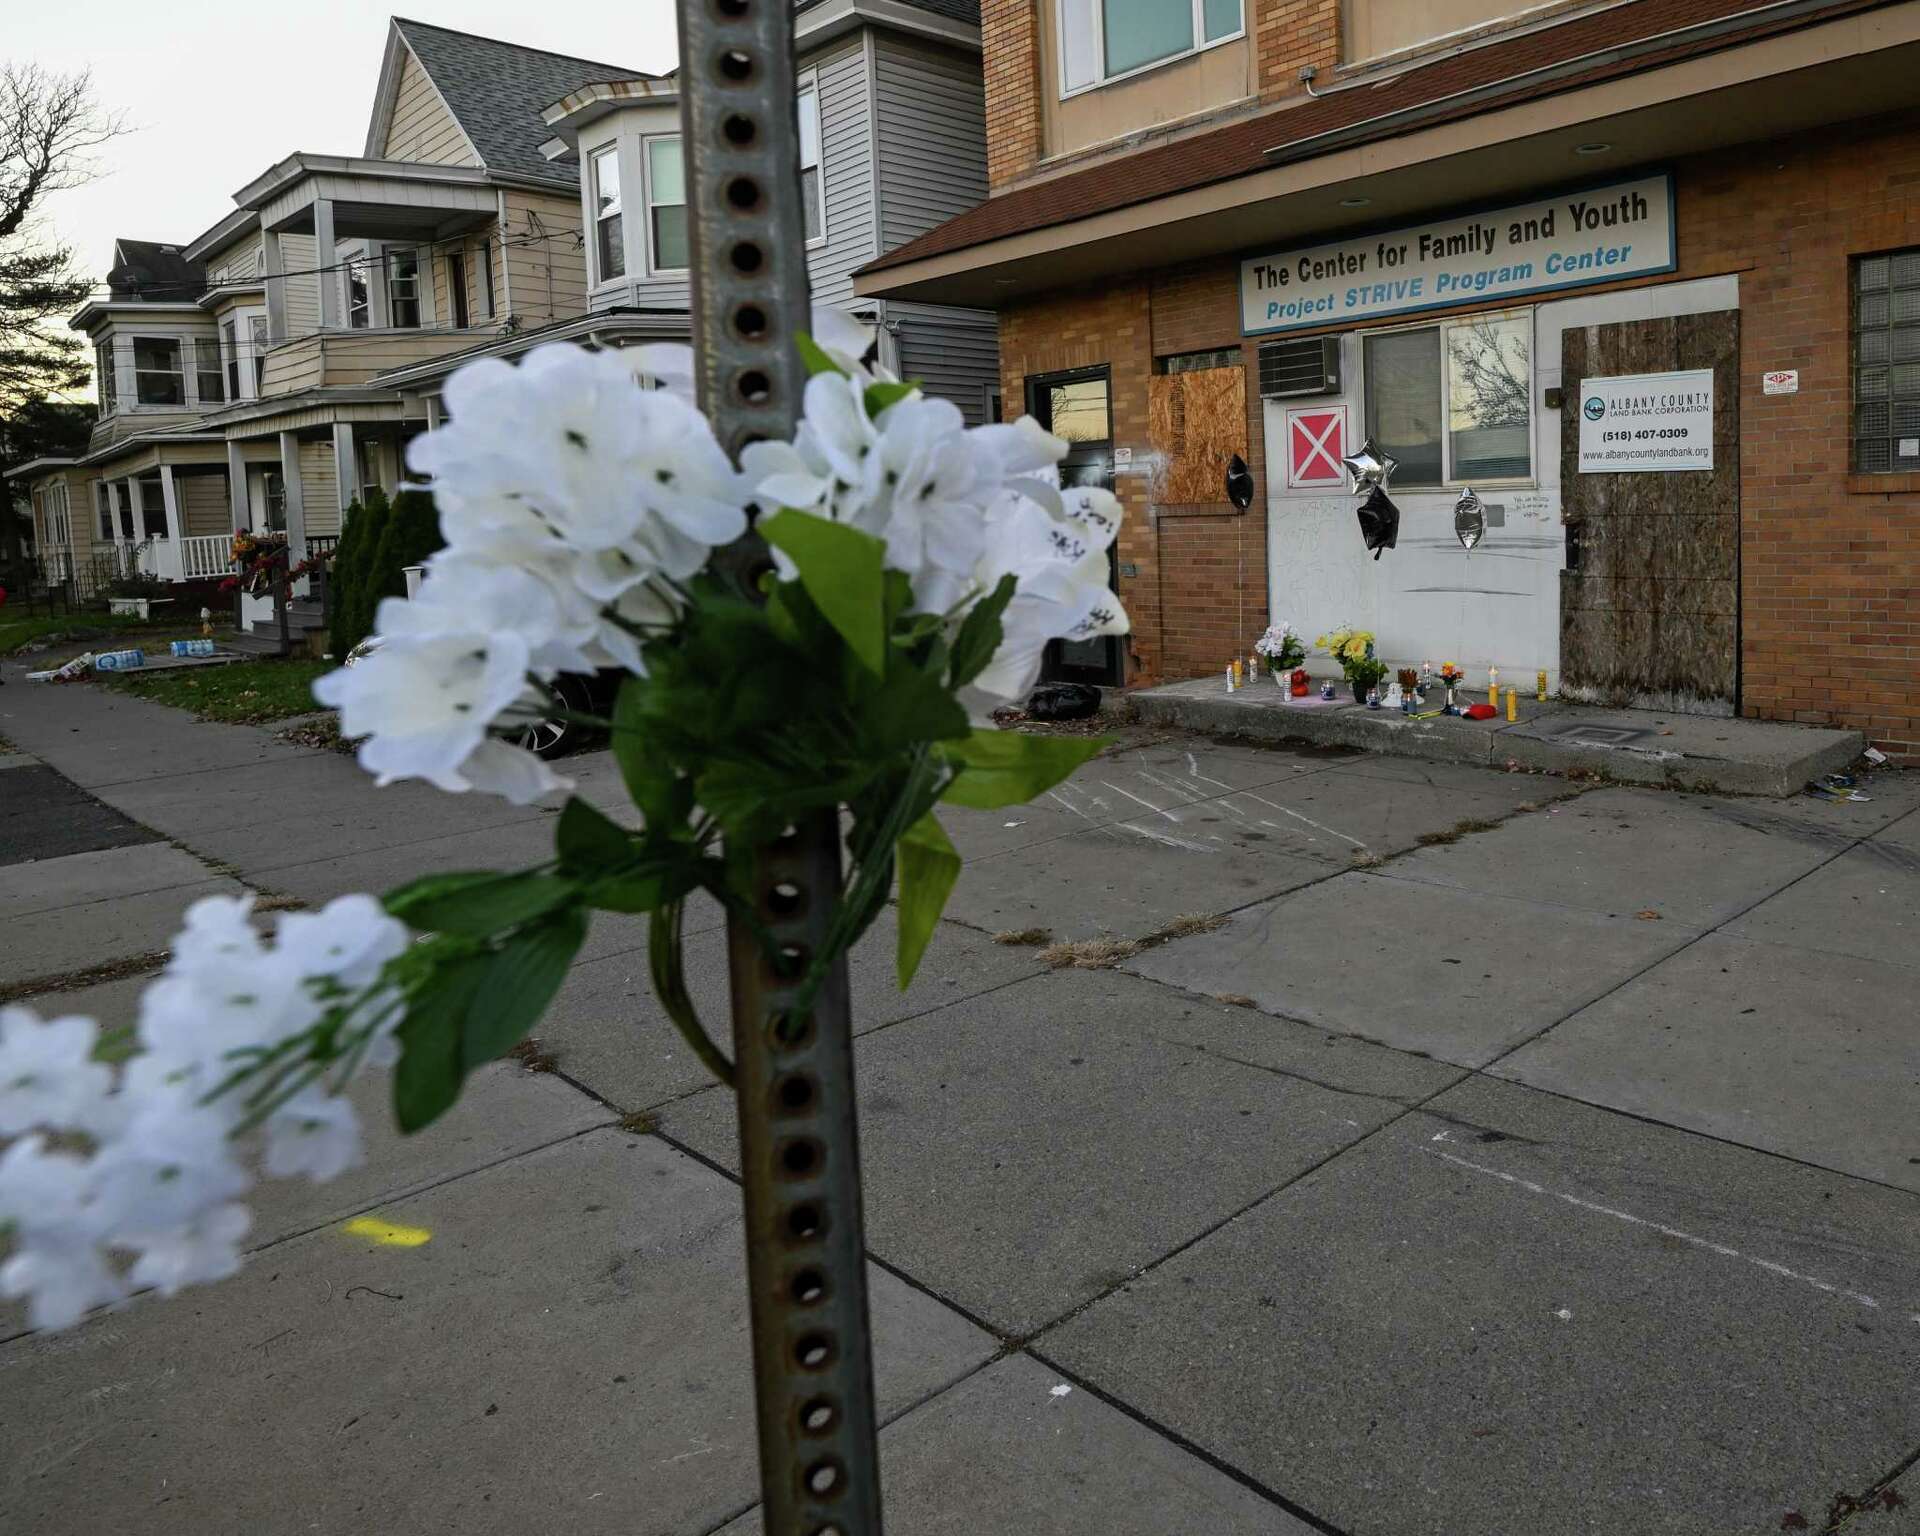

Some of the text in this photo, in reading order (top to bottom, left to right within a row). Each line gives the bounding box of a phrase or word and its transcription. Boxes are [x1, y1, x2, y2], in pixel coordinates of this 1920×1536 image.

[1253, 192, 1648, 290] The Center for Family and Youth
[1266, 244, 1633, 321] Project STRIVE Program Center
[1610, 393, 1709, 410] ALBANY COUNTY
[1655, 405, 1709, 415] CORPORATION
[1603, 428, 1688, 442] (518) 407-0309
[1583, 447, 1708, 460] www.albanycountylandbank.org
